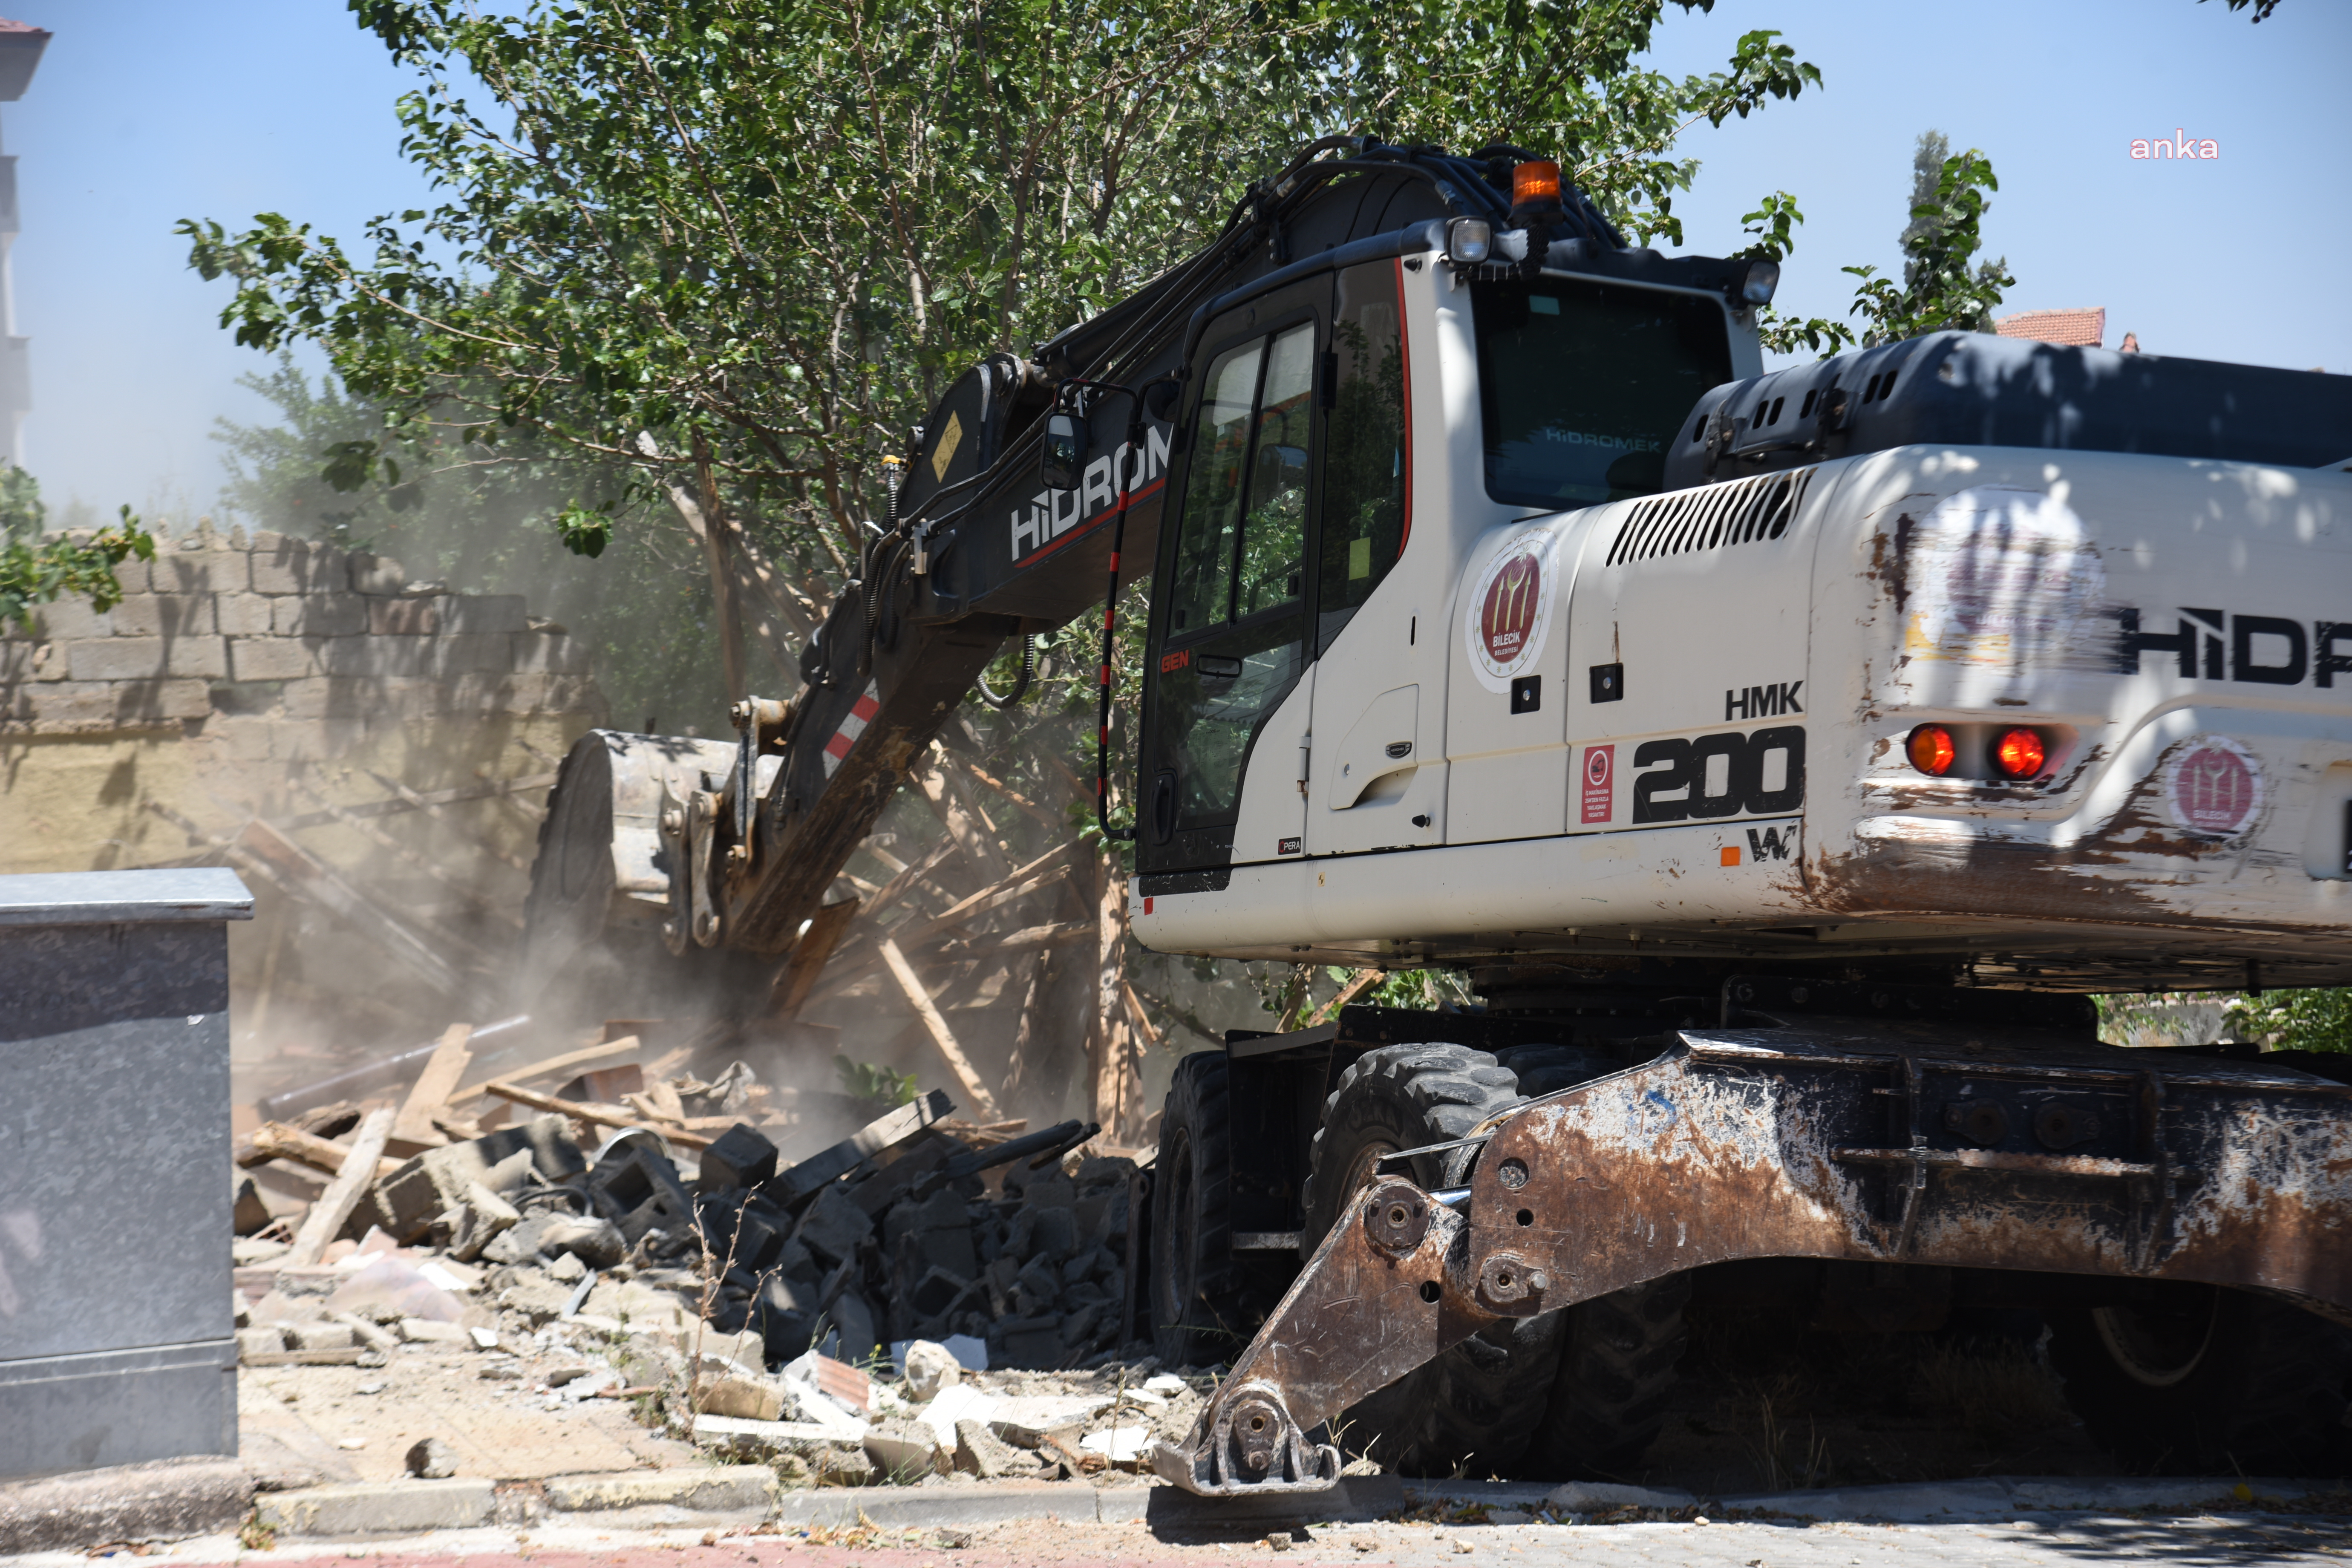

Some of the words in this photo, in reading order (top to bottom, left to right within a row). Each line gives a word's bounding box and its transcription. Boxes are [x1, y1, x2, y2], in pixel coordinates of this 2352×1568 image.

[1493, 629, 1520, 647] BİLECİK
[1162, 649, 1189, 673] GEN
[1494, 645, 1518, 656] BELEDİYESİ
[1725, 680, 1804, 721] HMK
[1632, 725, 1806, 824] 200
[1279, 840, 1300, 853] OPERA
[1747, 825, 1798, 863] W
